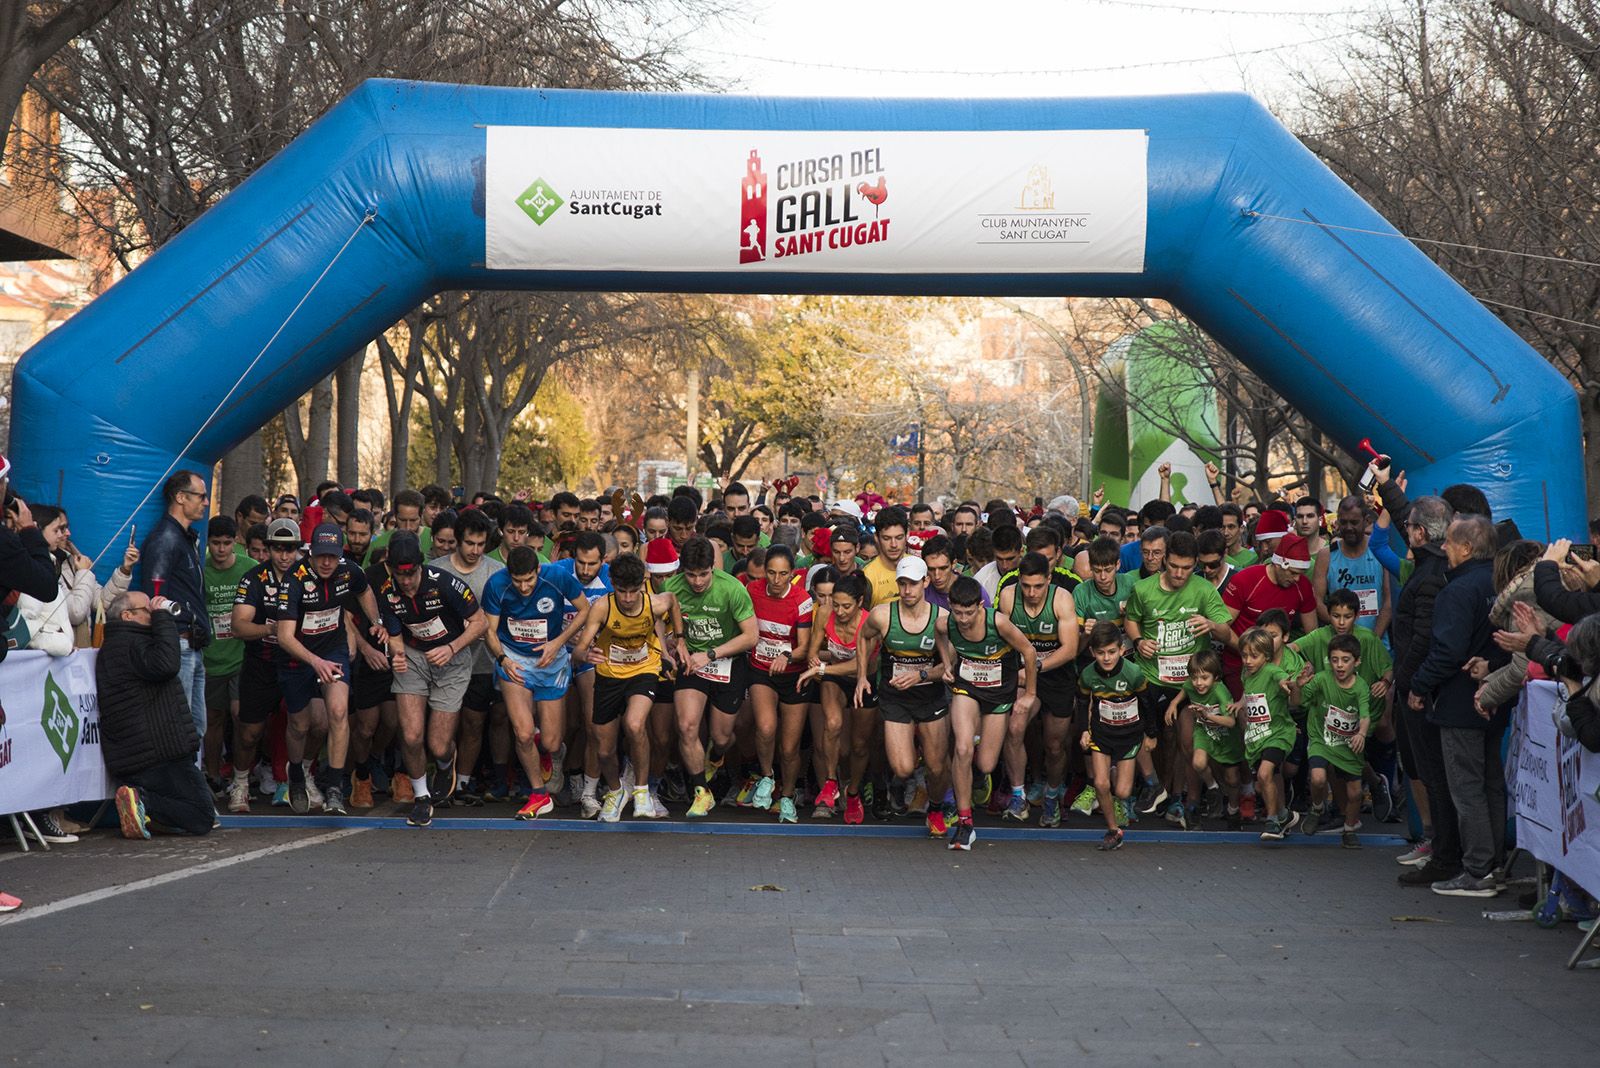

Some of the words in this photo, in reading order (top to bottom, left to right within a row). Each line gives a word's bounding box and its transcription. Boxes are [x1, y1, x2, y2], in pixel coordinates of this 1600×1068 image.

[776, 154, 843, 191] CURSA
[850, 147, 885, 177] DEL
[570, 190, 645, 200] AJUNTAMENT
[648, 190, 662, 200] DE
[569, 201, 662, 219] SantCugat
[776, 184, 858, 234] GALL
[981, 218, 1008, 228] CLUB
[1010, 217, 1087, 228] MUNTANYENC
[774, 231, 824, 258] SANT
[828, 218, 890, 249] CUGAT
[1000, 230, 1028, 239] SANT
[1030, 230, 1068, 239] CUGAT
[1356, 575, 1376, 584] TEAM
[514, 626, 541, 634] FRANCESC
[1165, 629, 1187, 642] GALL
[81, 716, 101, 745] Sant
[1333, 719, 1358, 731] 937
